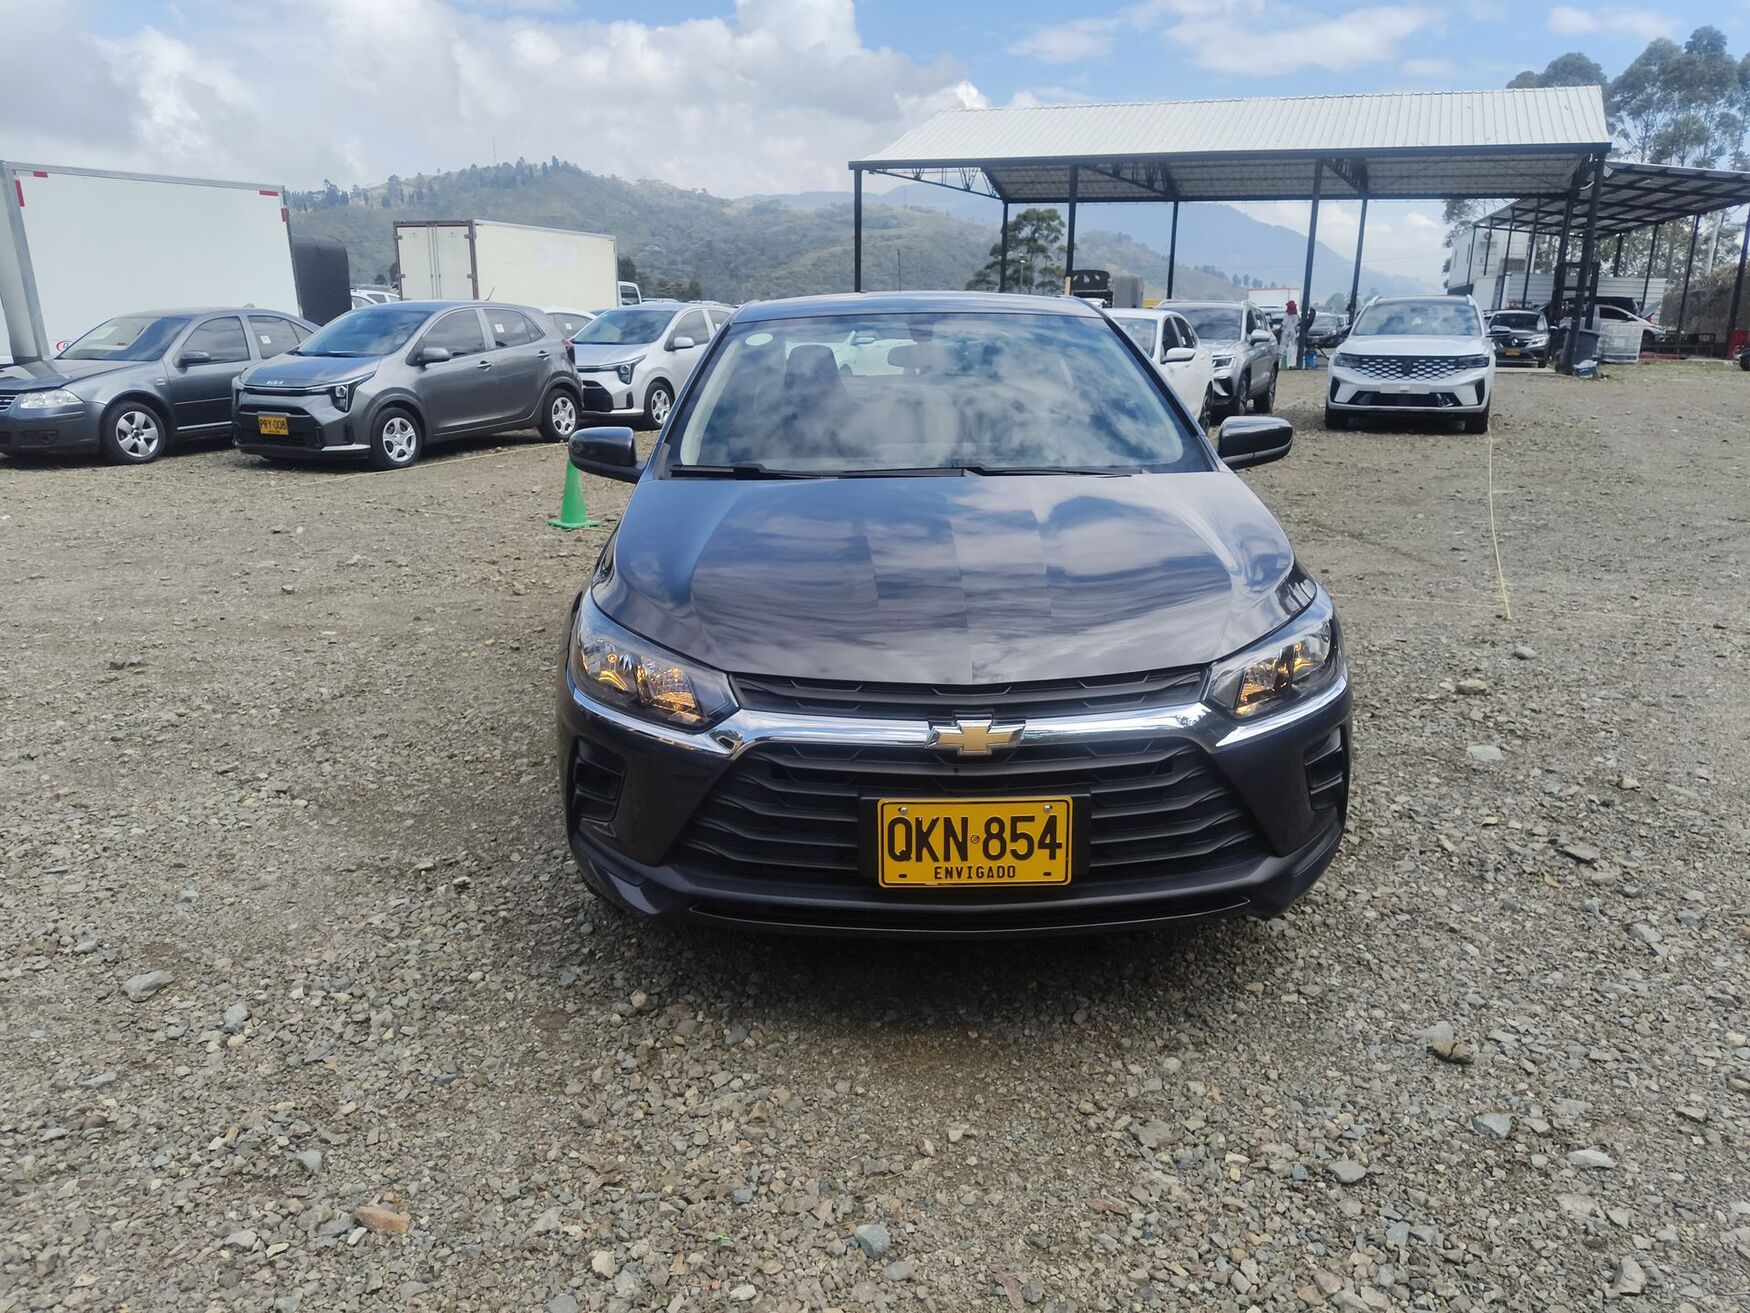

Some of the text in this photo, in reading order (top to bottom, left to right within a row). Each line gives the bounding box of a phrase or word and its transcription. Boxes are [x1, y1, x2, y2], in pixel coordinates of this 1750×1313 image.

[887, 815, 1062, 862] QKN 854
[934, 865, 1016, 880] ENVIGADO
